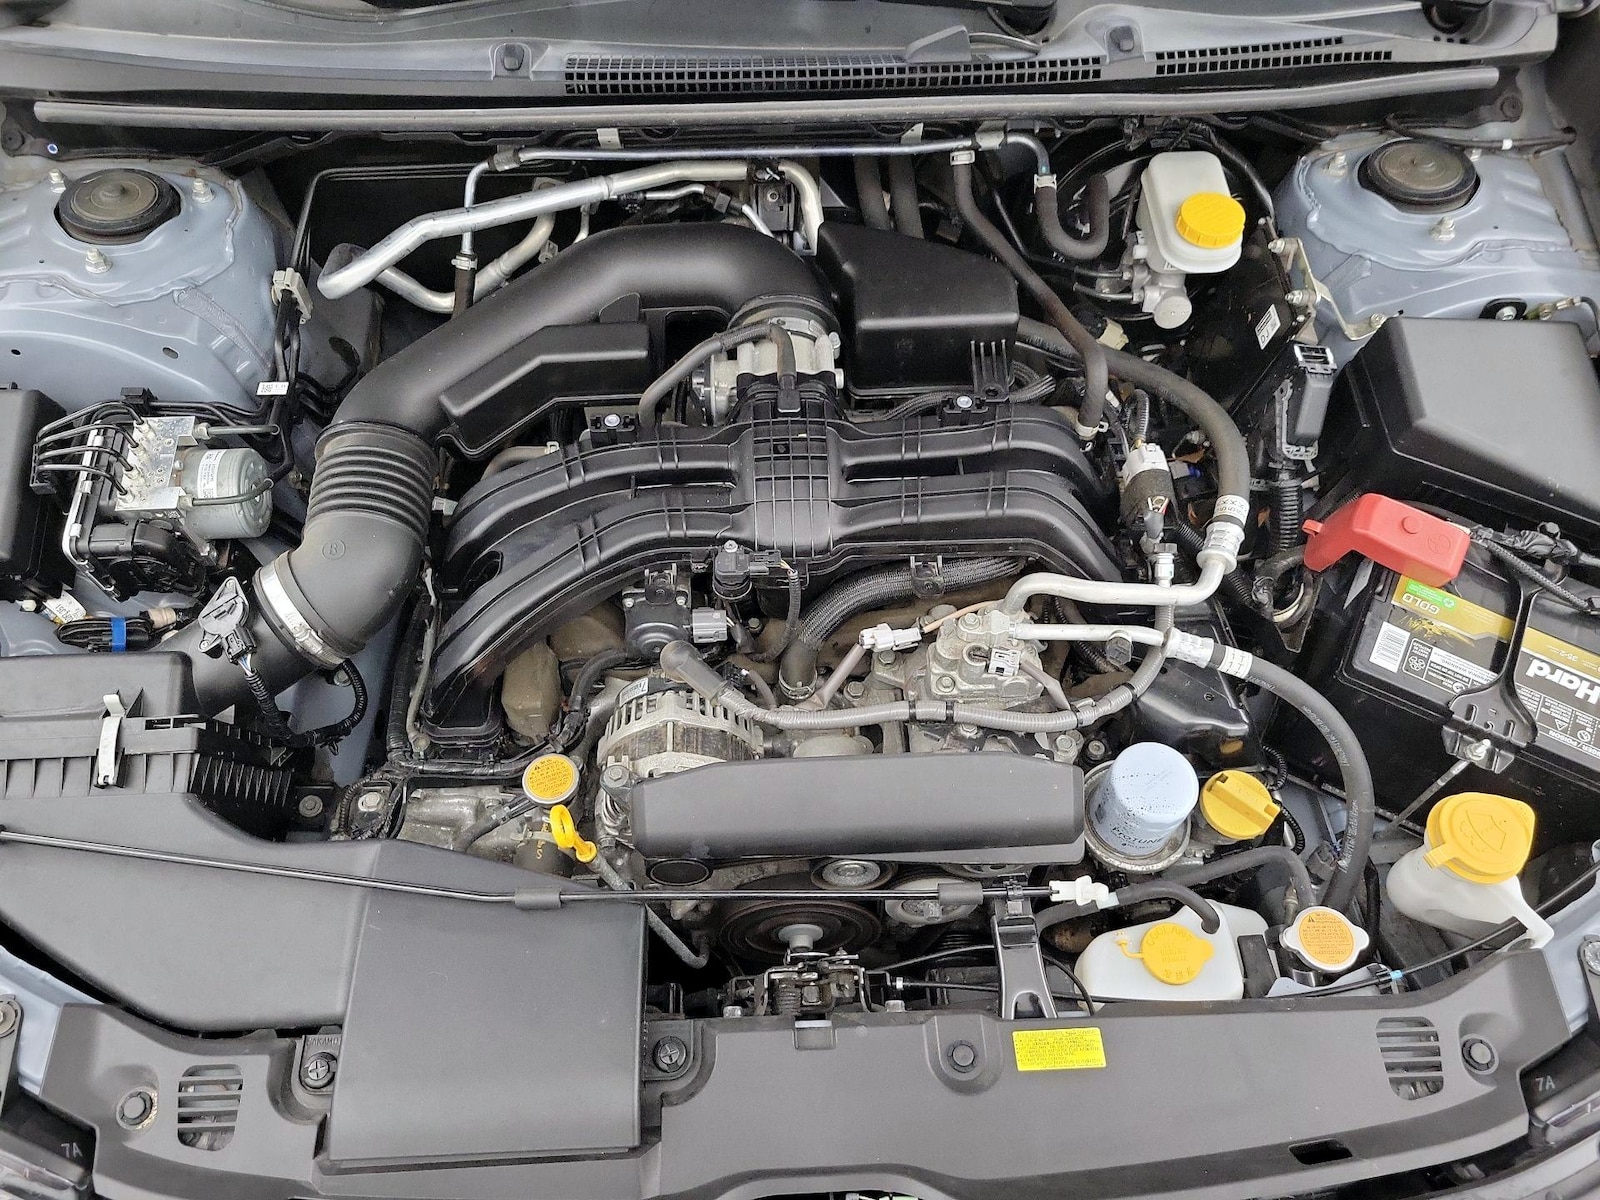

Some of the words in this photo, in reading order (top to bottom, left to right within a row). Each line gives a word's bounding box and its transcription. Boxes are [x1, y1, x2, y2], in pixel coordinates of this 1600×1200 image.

[1402, 593, 1439, 614] GOLD
[1526, 659, 1600, 705] Hard
[1146, 925, 1193, 947] COOLANT
[1535, 1075, 1555, 1091] 7A
[61, 1142, 83, 1158] 7A
